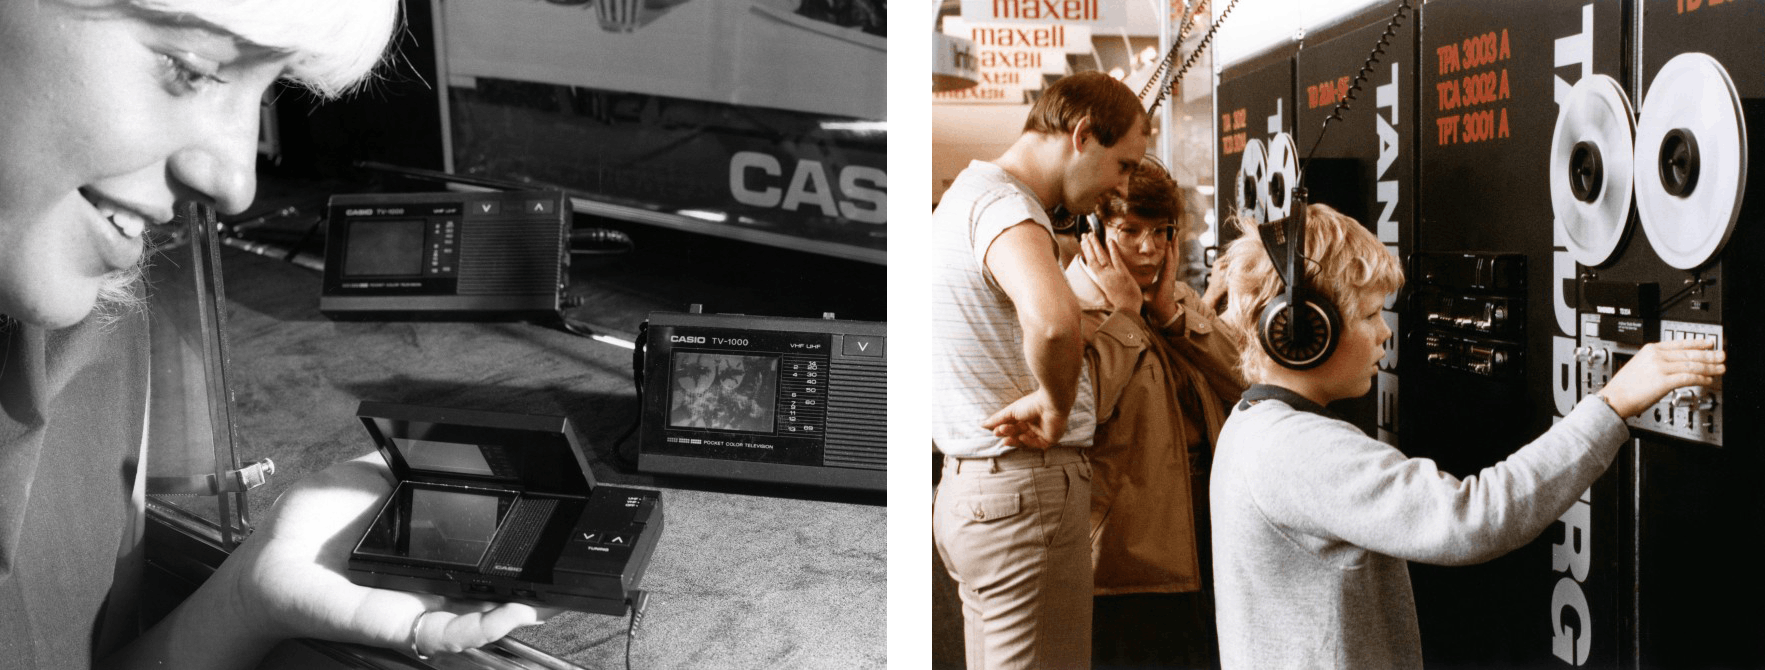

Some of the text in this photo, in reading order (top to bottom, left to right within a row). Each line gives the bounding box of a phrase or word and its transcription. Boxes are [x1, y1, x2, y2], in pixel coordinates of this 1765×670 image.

[993, 0, 1098, 20] maxell
[972, 25, 1064, 48] maxell
[981, 51, 1042, 69] axell
[1437, 28, 1510, 75] TPA 3003 A
[981, 72, 1020, 84] xell
[1437, 68, 1509, 110] TCA 3002 A
[1436, 107, 1509, 145] TPT 3001 A
[729, 151, 888, 224] CAS
[670, 335, 749, 346] CASIO TV-1000
